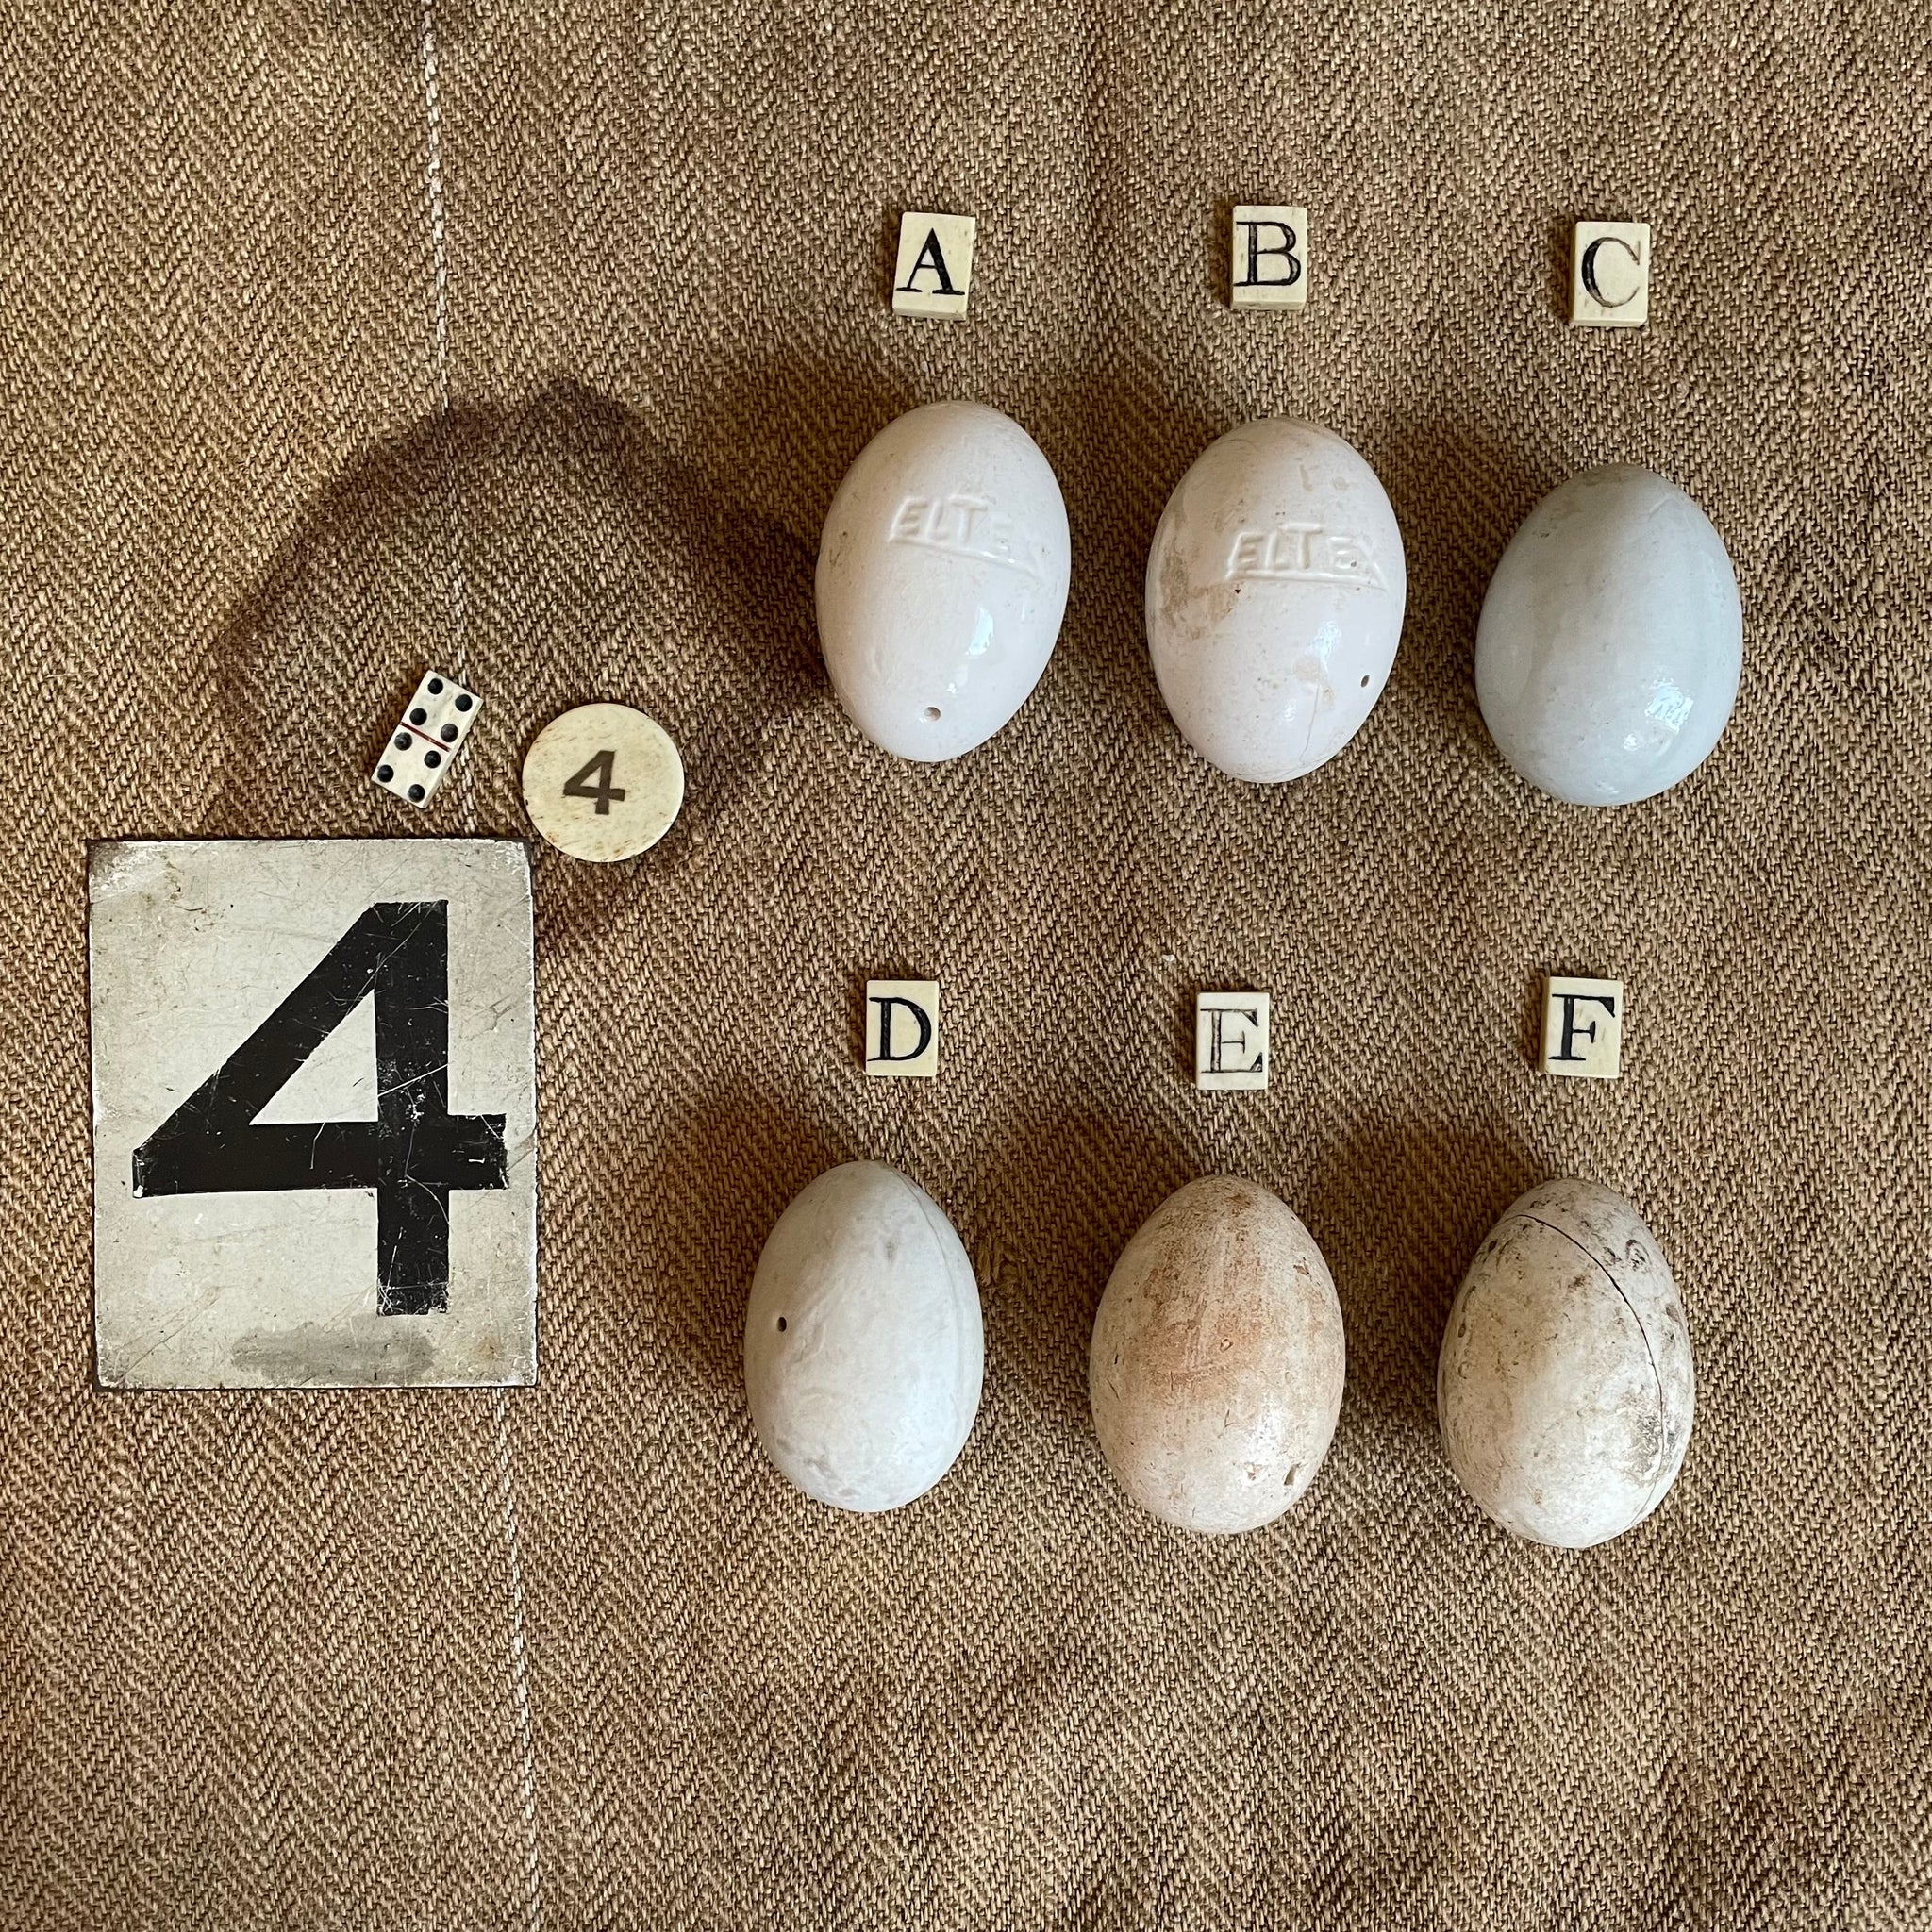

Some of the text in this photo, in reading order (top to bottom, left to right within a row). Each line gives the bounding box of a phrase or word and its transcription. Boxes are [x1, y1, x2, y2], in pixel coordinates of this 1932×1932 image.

[895, 227, 965, 295] A
[1234, 222, 1301, 287] B
[1581, 237, 1641, 308] C
[887, 492, 1044, 581] ELTE
[562, 749, 626, 815] 4
[866, 997, 932, 1062] D
[1200, 1008, 1263, 1074] E
[1548, 994, 1616, 1062] F
[132, 899, 509, 1316] 4
